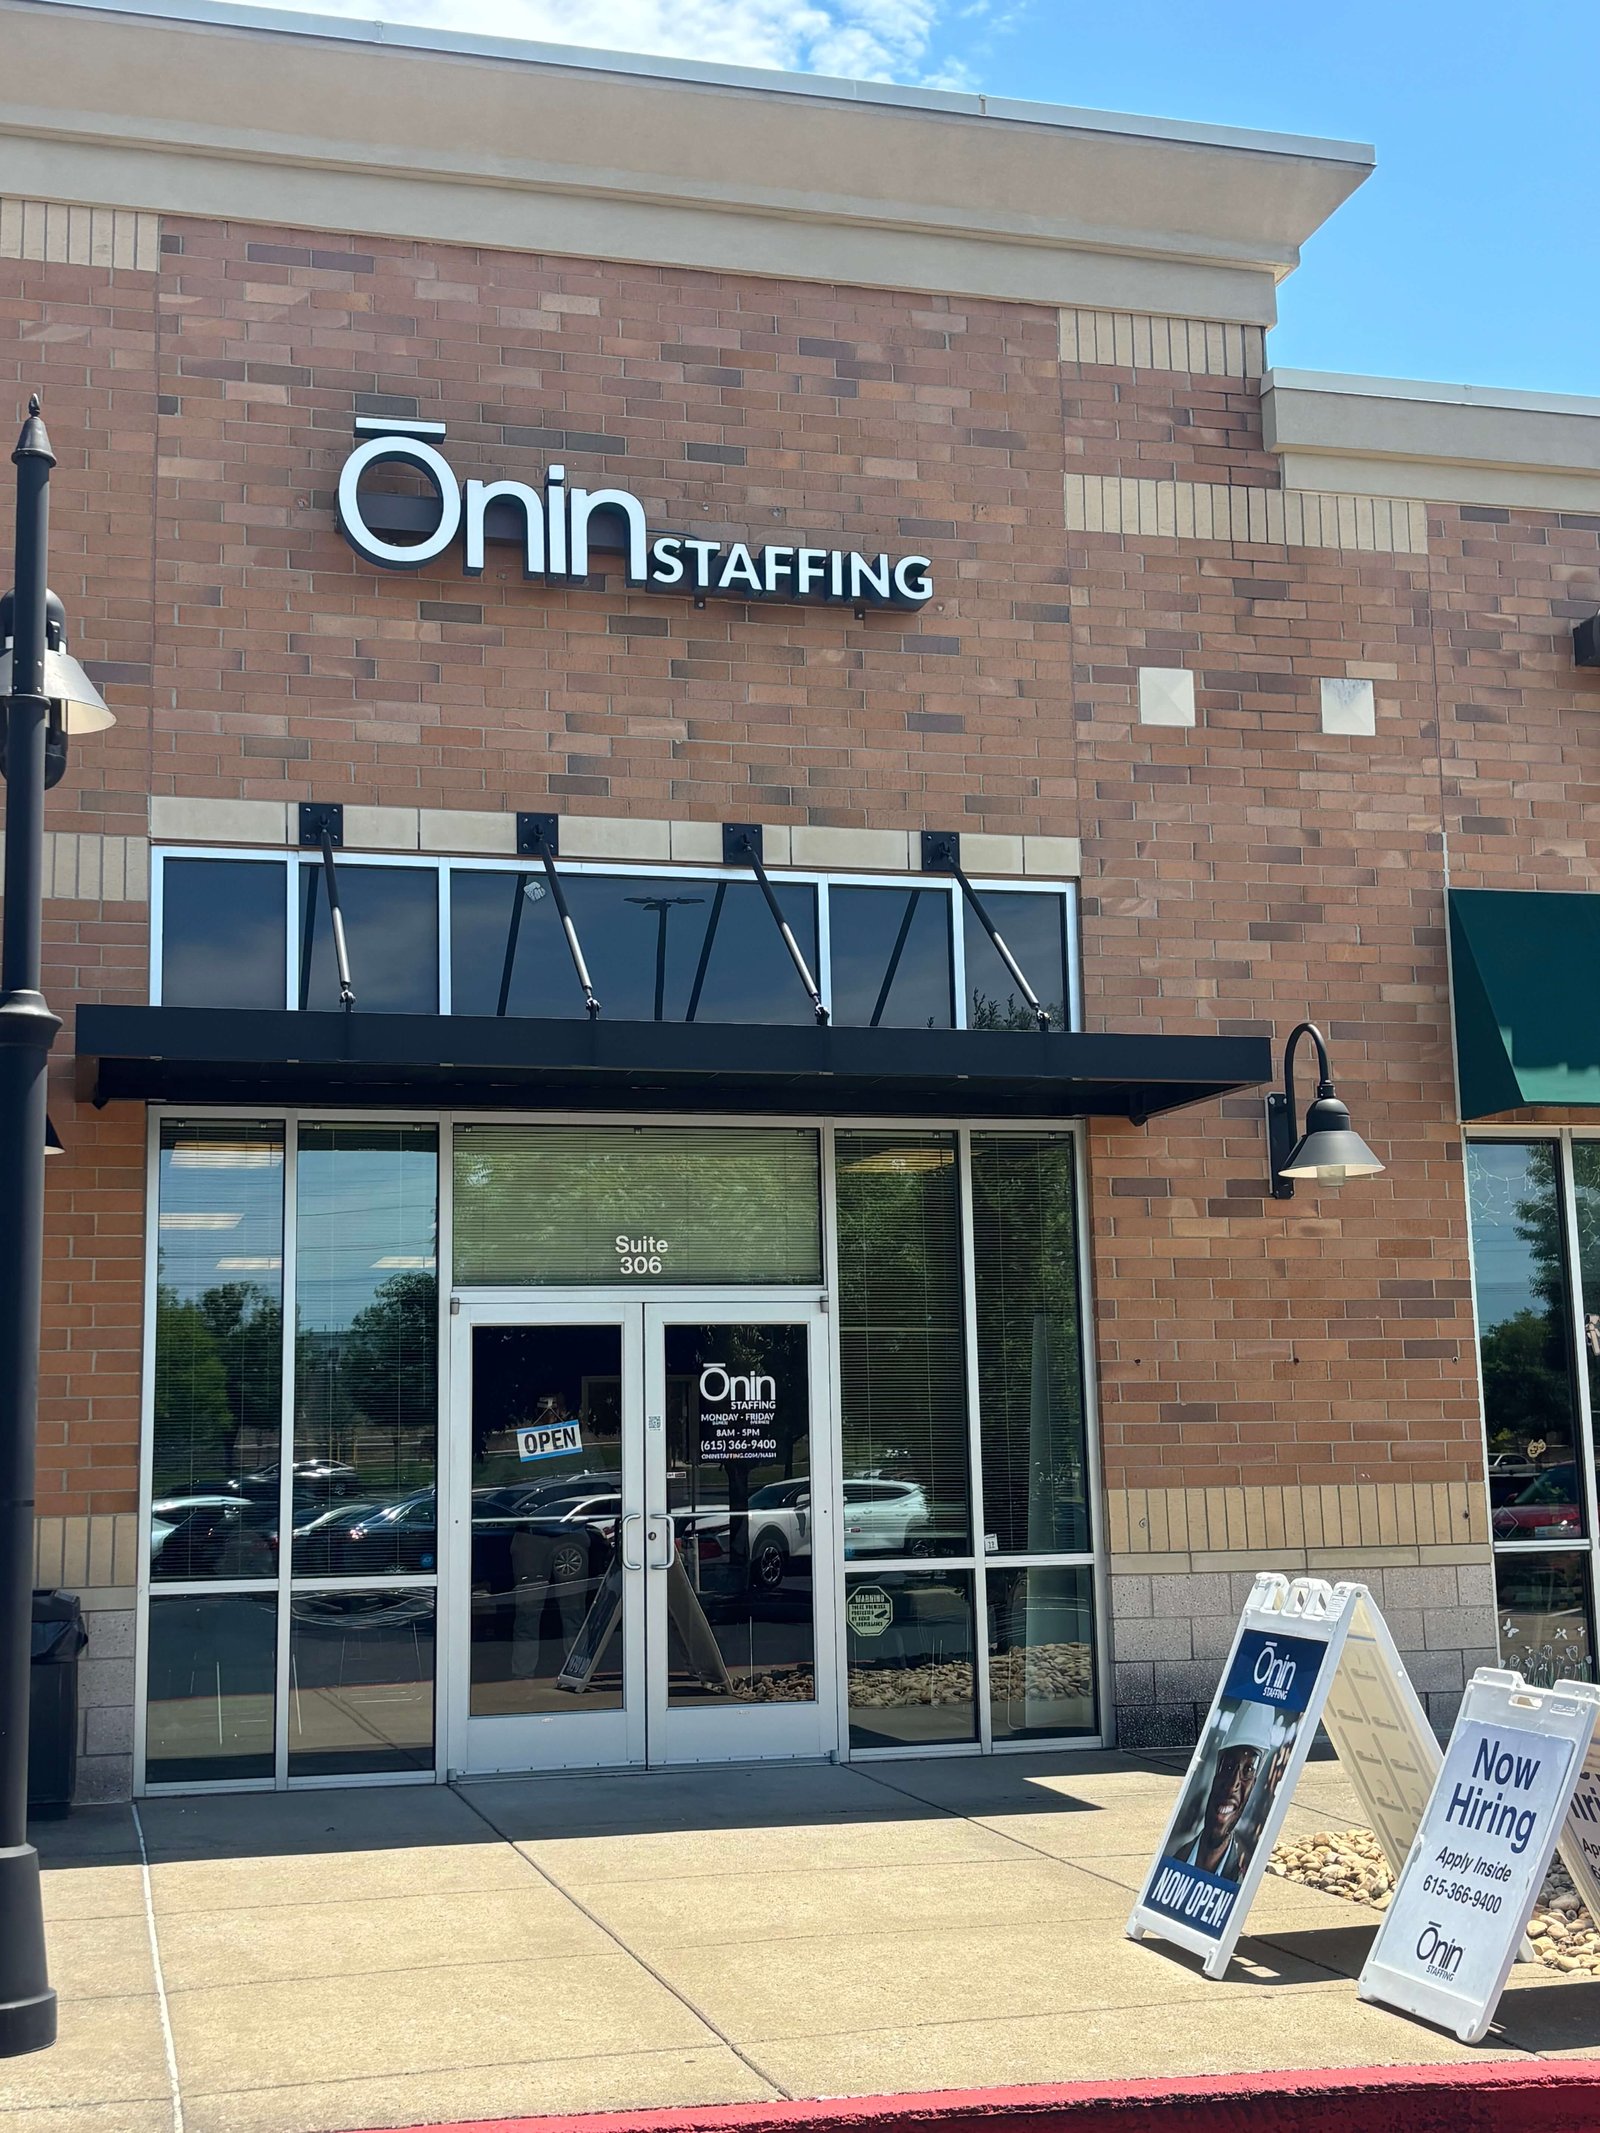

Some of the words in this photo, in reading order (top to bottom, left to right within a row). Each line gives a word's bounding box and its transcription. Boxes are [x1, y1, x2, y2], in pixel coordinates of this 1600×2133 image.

[652, 537, 934, 600] STAFFING
[615, 1235, 669, 1253] Suite
[620, 1256, 662, 1274] 306
[731, 1401, 776, 1410] STAFFING
[701, 1413, 739, 1422] MONDAY
[745, 1412, 775, 1421] FRIDAY
[524, 1427, 577, 1454] OPEN
[716, 1429, 735, 1437] 8AM
[742, 1428, 760, 1437] 5PM
[700, 1440, 726, 1452] (615)
[728, 1439, 777, 1450] 366-9400
[1262, 1687, 1288, 1700] STAFFING
[1472, 1738, 1541, 1790] Now
[1446, 1783, 1537, 1853] Hiring
[1435, 1846, 1474, 1874] Apply
[1473, 1856, 1512, 1882] Inside
[1151, 1867, 1195, 1910] NOW
[1185, 1881, 1234, 1928] OPEN!
[1423, 1874, 1502, 1914] 615-366-9400
[1426, 1965, 1455, 1981] STAFFING
